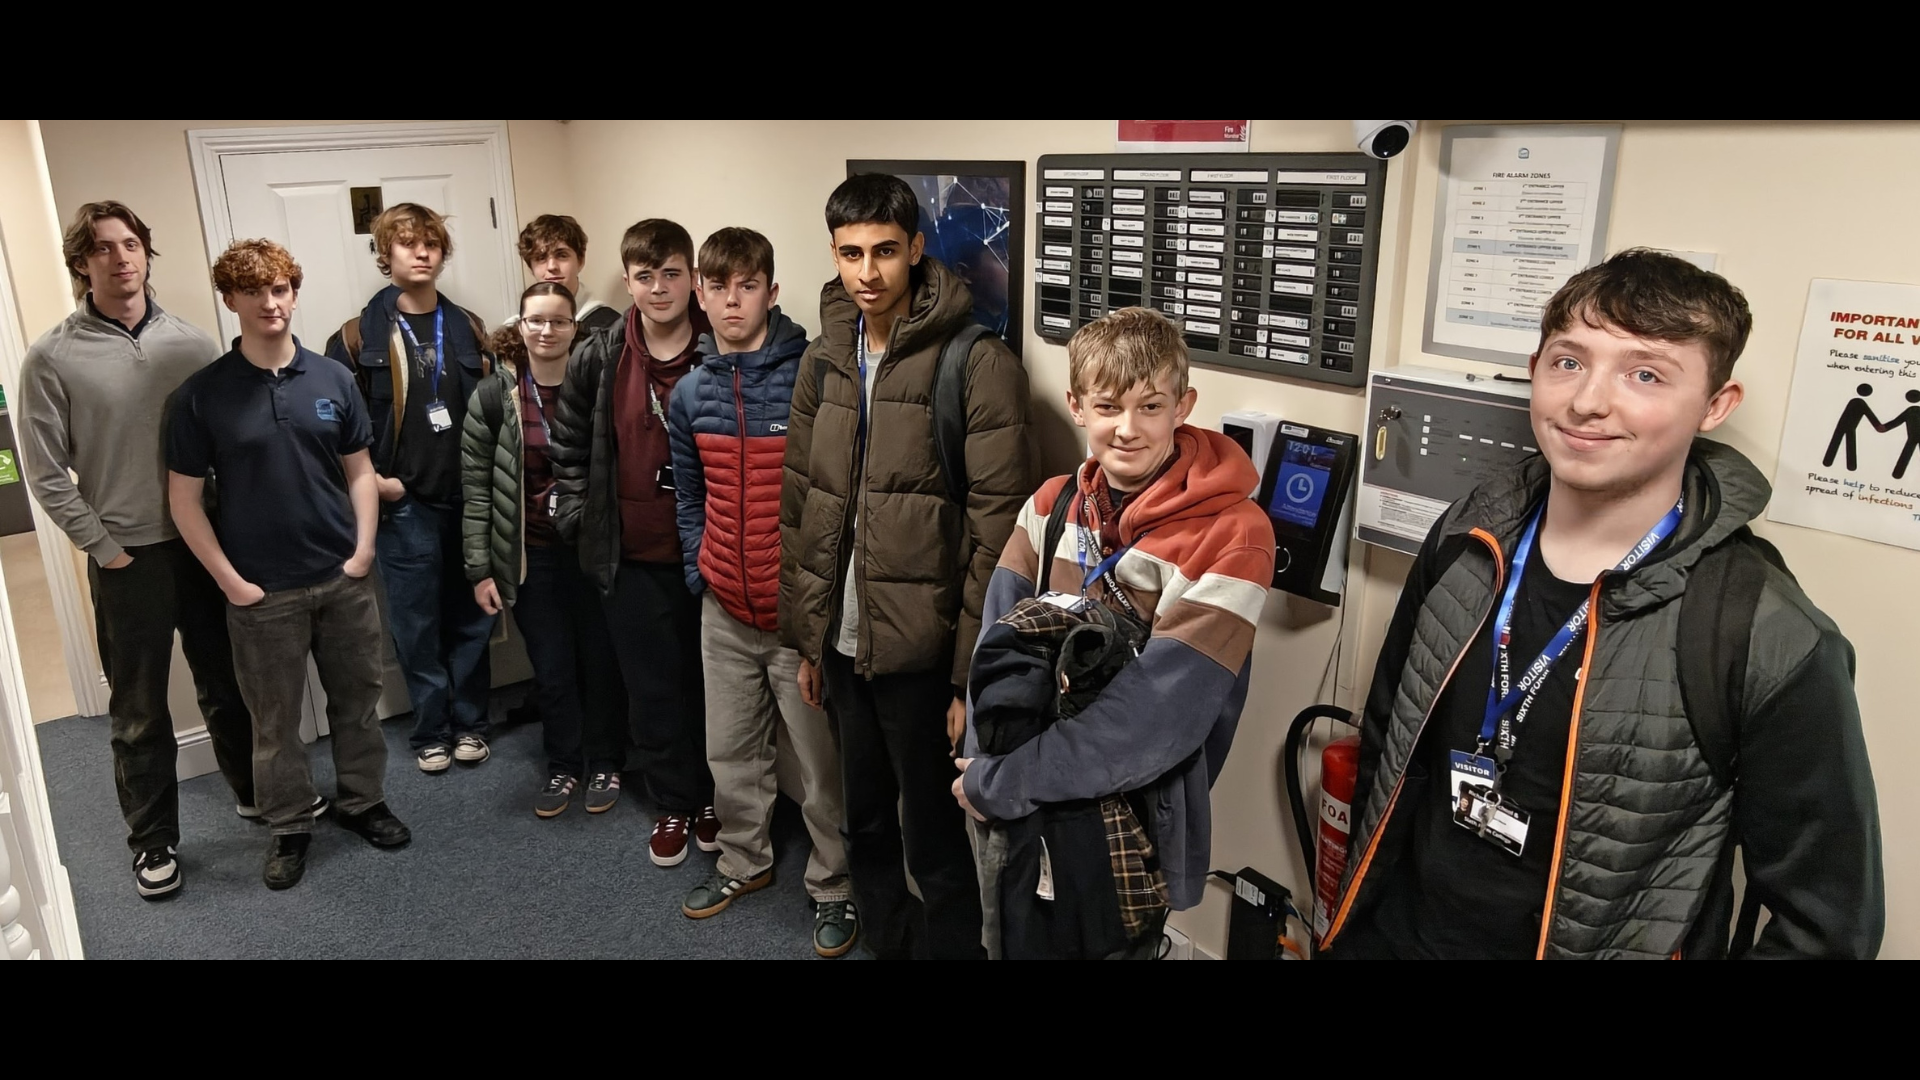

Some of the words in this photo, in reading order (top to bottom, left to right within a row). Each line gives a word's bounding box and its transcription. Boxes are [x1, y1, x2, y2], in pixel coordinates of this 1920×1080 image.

[1830, 312, 1920, 329] IMPORTAN
[1834, 328, 1868, 340] FOR
[1872, 332, 1904, 344] ALL
[1830, 349, 1859, 359] Please
[1863, 354, 1900, 364] sanitise
[1826, 361, 1850, 370] when
[1854, 365, 1894, 378] entering
[1898, 369, 1917, 378] this
[1808, 472, 1839, 484] Please
[1844, 478, 1866, 492] help
[1805, 485, 1838, 495] spread
[1842, 490, 1854, 500] of
[1858, 494, 1914, 510] infections
[1620, 532, 1660, 570] VISITOR
[1567, 601, 1589, 632] SITOR
[1500, 652, 1509, 672] XTH
[1517, 654, 1551, 691] VISITOR
[1500, 674, 1509, 698] FOR
[1516, 694, 1534, 723] SIXTH
[1500, 720, 1509, 750] SIXTH
[1455, 762, 1490, 776] VISITOR
[1321, 798, 1348, 825] FOA
